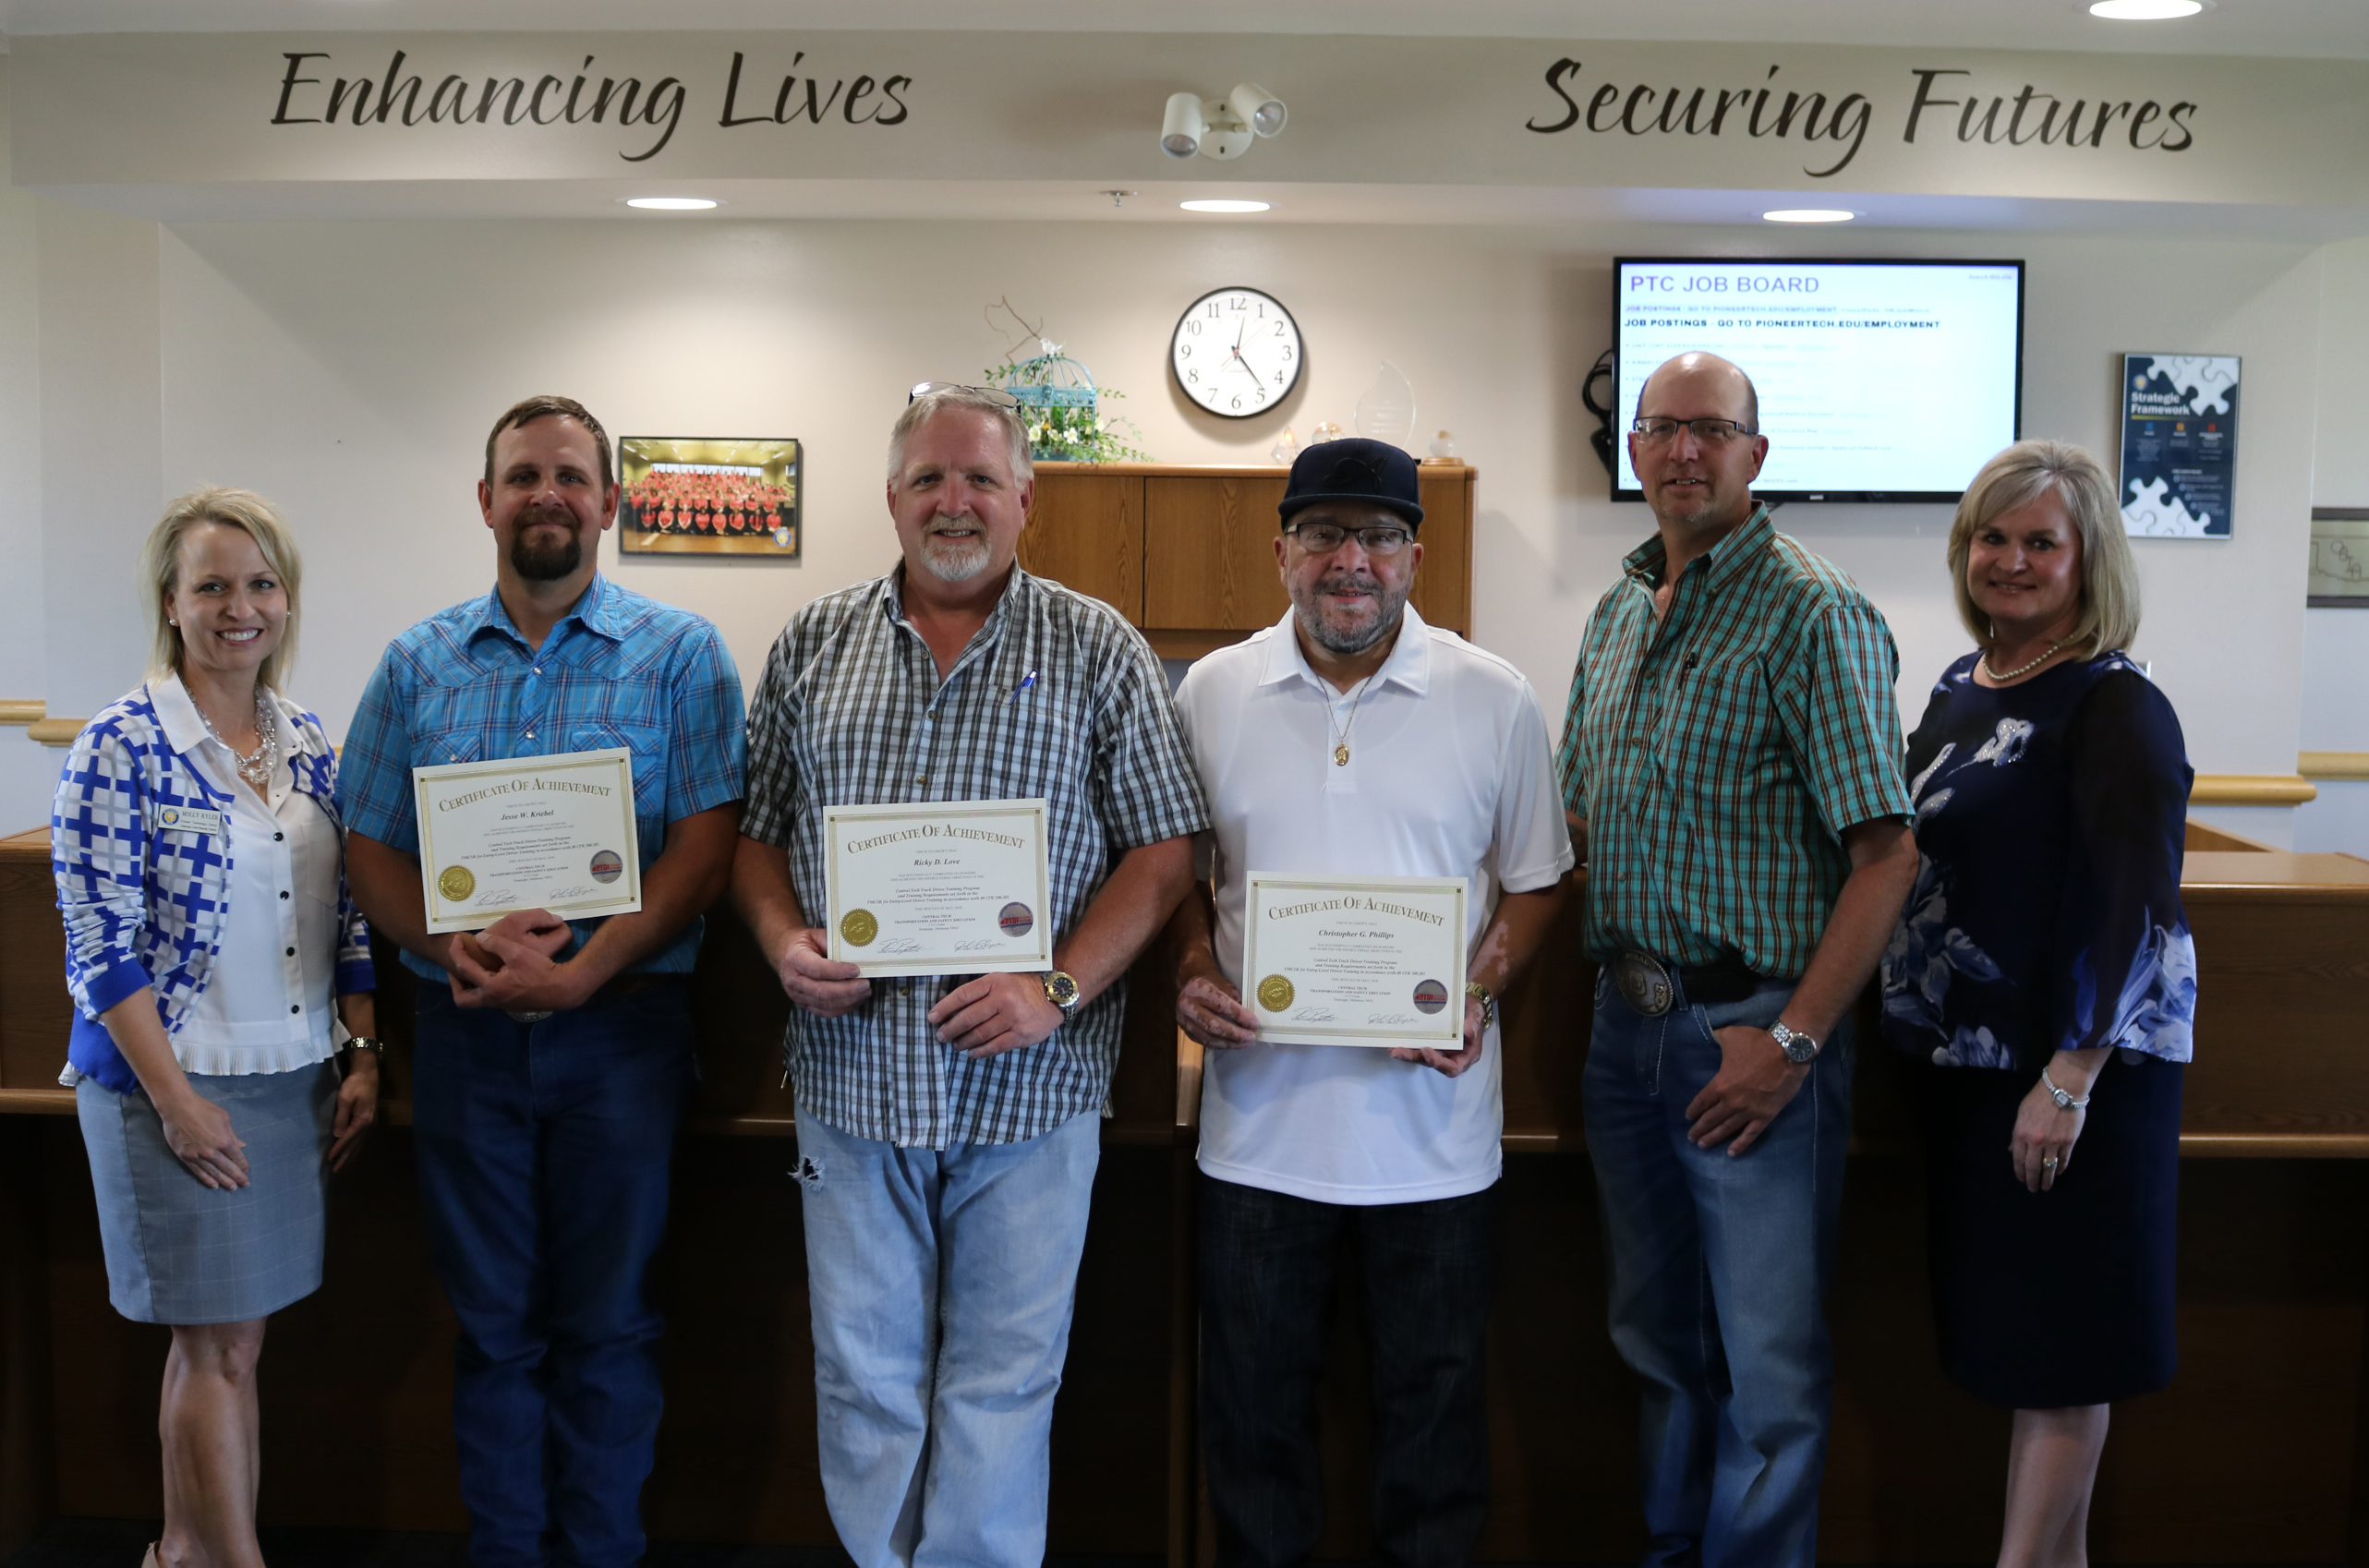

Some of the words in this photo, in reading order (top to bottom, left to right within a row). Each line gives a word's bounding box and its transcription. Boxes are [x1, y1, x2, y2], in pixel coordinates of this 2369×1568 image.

[270, 50, 686, 162] Enhancing
[718, 52, 913, 127] Lives
[1526, 58, 1871, 177] Securing
[1903, 68, 2197, 151] Futures
[1631, 275, 1674, 293] PTC
[1683, 276, 1728, 293] JOB
[1737, 276, 1819, 293] BOARD
[1207, 303, 1220, 318] 11
[1229, 297, 1247, 310] 12
[1258, 303, 1264, 318] 1
[1187, 320, 1202, 336] 10
[1274, 320, 1285, 336] 2
[1756, 320, 1940, 328] PIONEERTECH.EDU/EMPLOYMENT
[1180, 344, 1191, 360] 9
[1282, 344, 1292, 361] 3
[1188, 368, 1199, 383] 8
[1274, 369, 1284, 384] 4
[1208, 388, 1218, 404] 7
[1231, 393, 1241, 410] 6
[1255, 388, 1266, 404] 5
[2131, 391, 2180, 404] Strategic
[2131, 404, 2190, 416] Framework
[439, 783, 510, 813] CERTIFICATE
[511, 778, 528, 792] OF
[532, 778, 611, 797] ACHIEVEMENT
[200, 813, 218, 821] KYLER
[500, 813, 519, 821] Jesse
[529, 809, 553, 818] Kriebel
[847, 828, 921, 854] CERTIFICATE
[922, 824, 939, 837] OF
[942, 824, 1025, 849] ACHIEVEMENT
[913, 859, 933, 867] Ricky
[1268, 899, 1342, 921] CERTIFICATE
[1343, 896, 1362, 910] OF
[1363, 897, 1445, 927] ACHIEVEMENT
[1318, 929, 1358, 939] Christopher
[1368, 931, 1395, 940] Phillips
